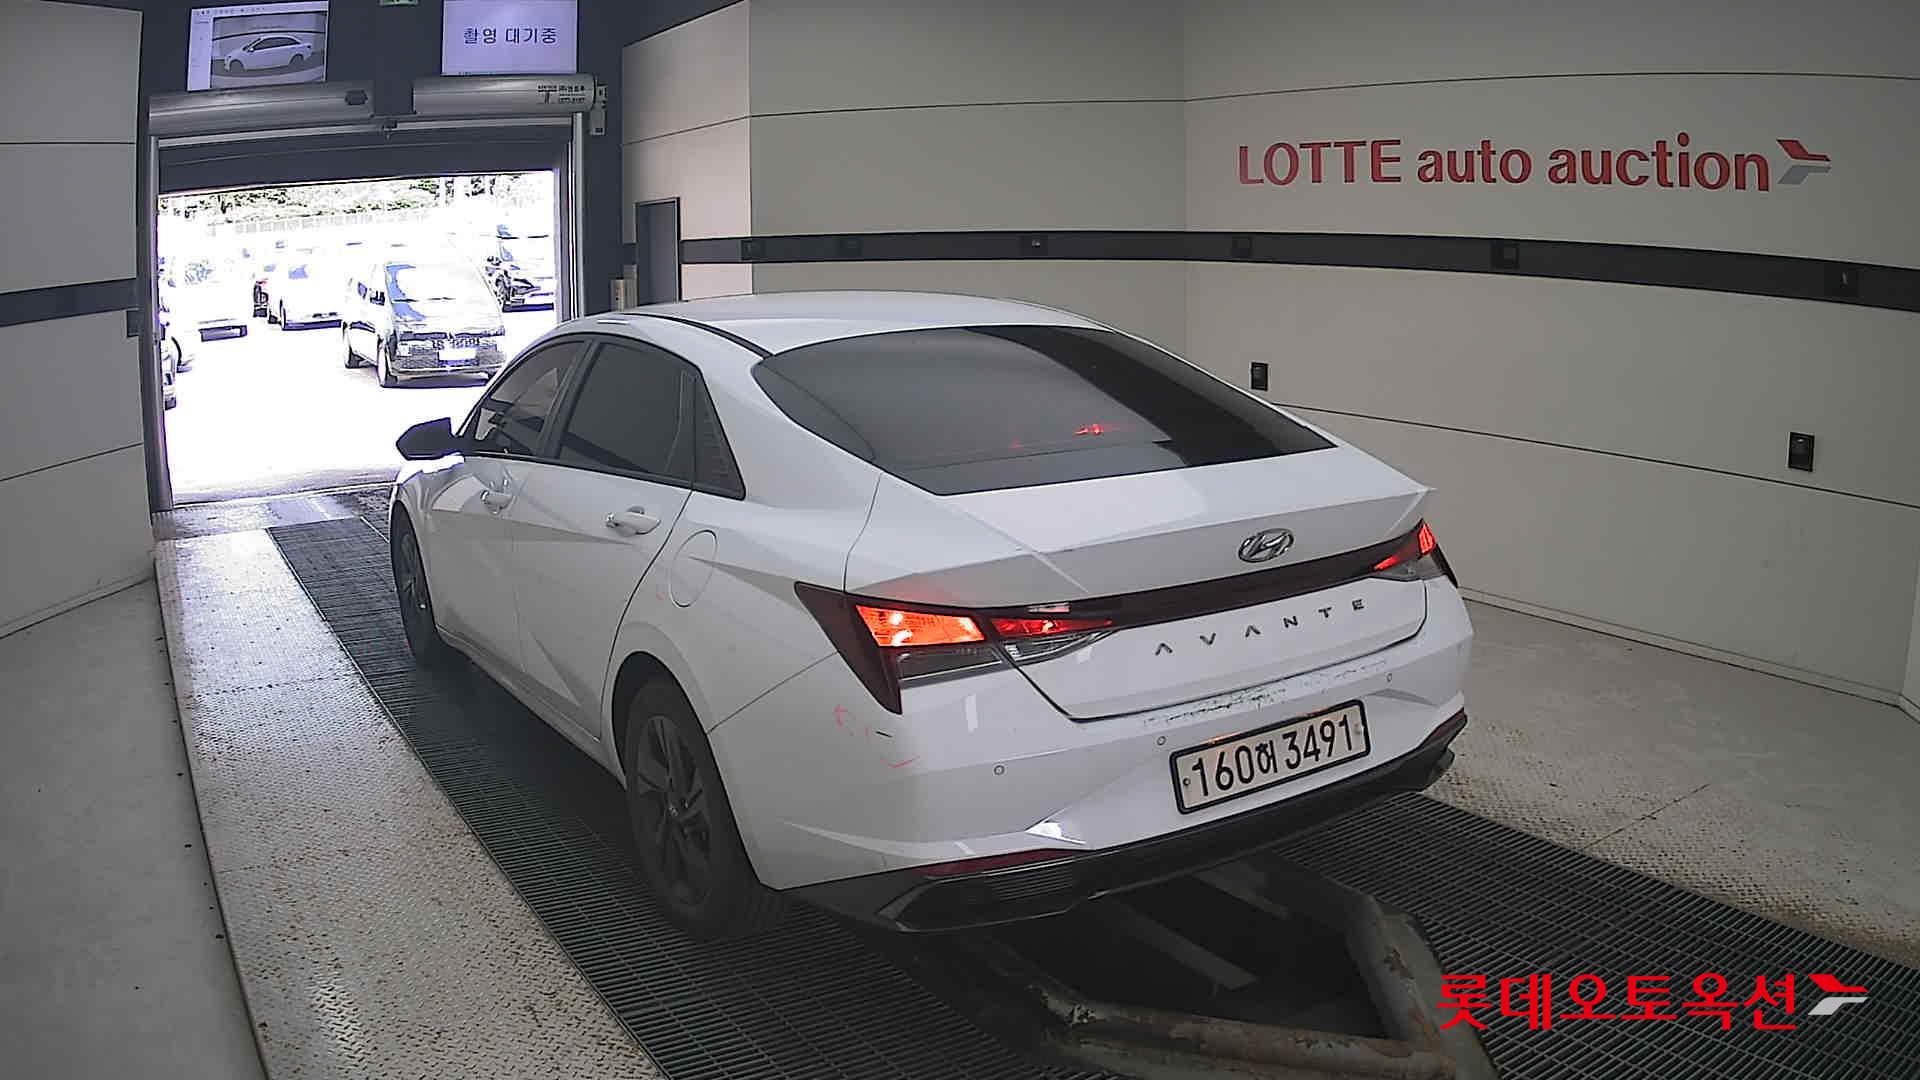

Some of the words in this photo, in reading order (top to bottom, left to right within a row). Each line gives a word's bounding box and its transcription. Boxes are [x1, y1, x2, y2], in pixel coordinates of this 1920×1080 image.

[505, 27, 557, 44] 대기중
[1239, 139, 1401, 186] LOTTE
[1417, 139, 1533, 185] auto
[1547, 132, 1770, 192] auction
[1155, 599, 1365, 656] AVANTE
